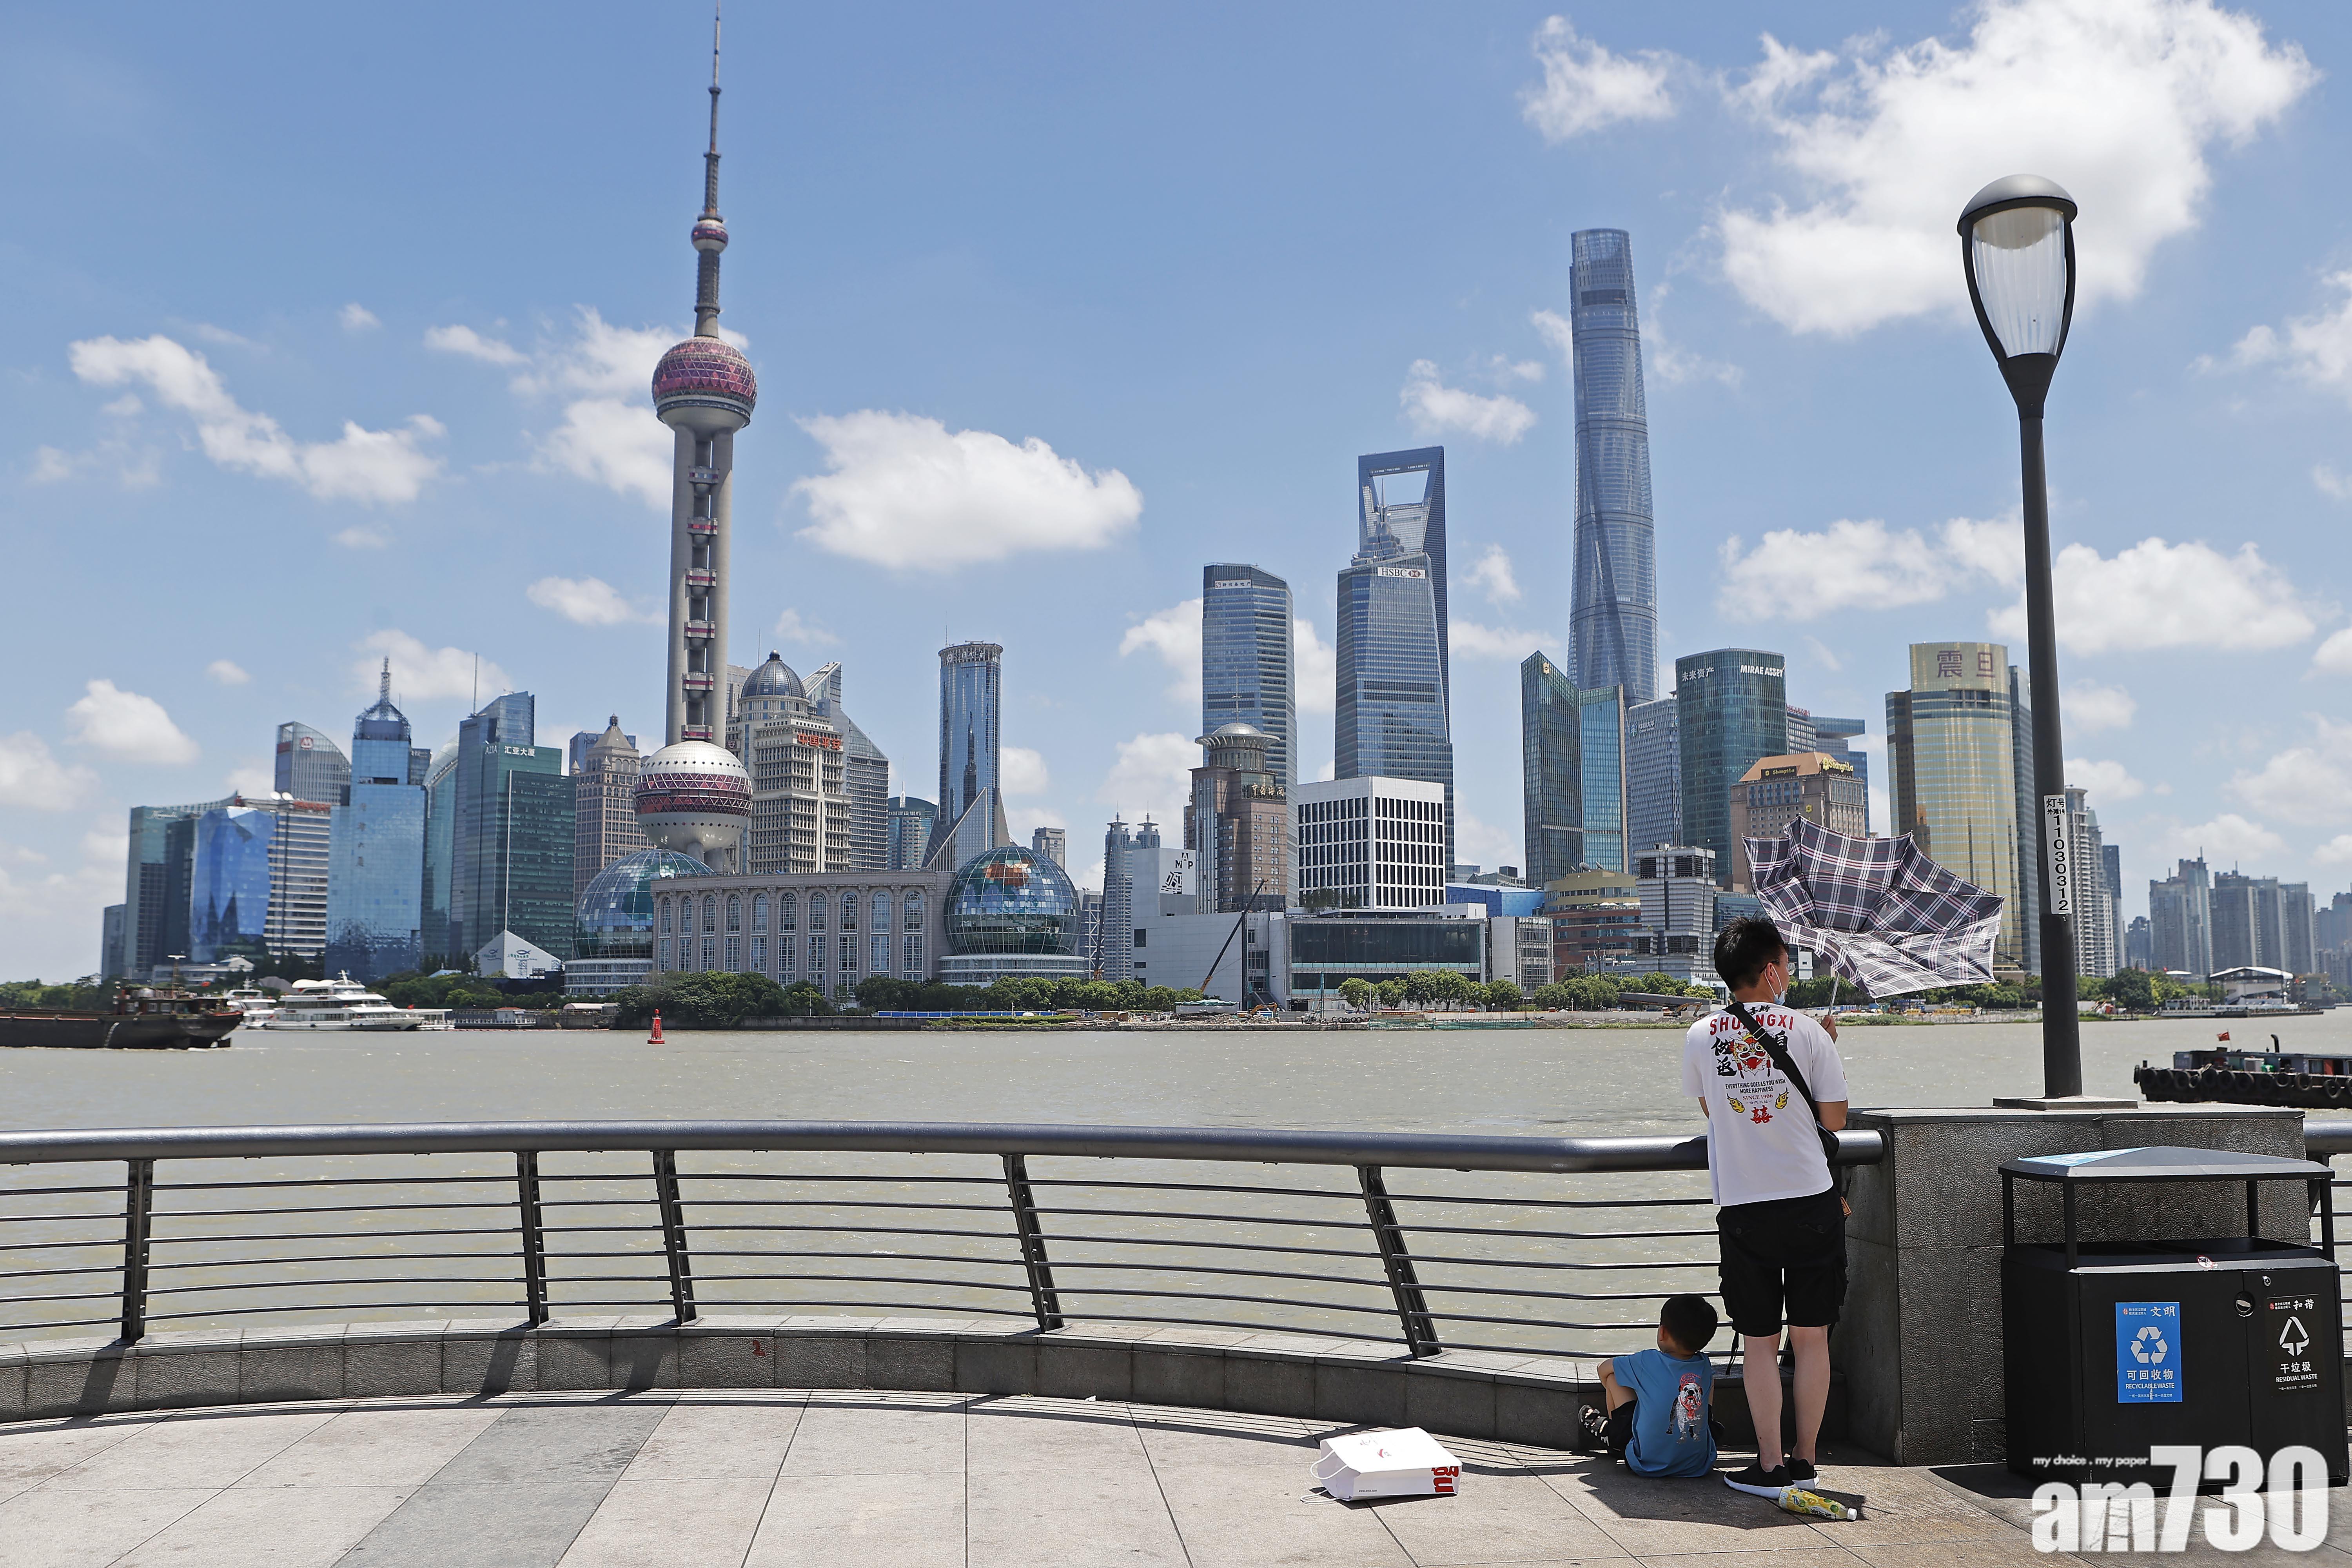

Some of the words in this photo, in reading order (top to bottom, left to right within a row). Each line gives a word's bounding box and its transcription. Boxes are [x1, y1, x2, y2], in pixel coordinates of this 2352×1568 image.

[1382, 568, 1407, 577] HSBC
[1740, 665, 1764, 675] MIRAE
[1937, 651, 1995, 678] 震旦
[1682, 666, 1715, 682] 未来资产
[798, 733, 841, 750] 中国平安
[505, 746, 535, 757] 汇亚大厦
[2046, 798, 2065, 808] 灯号
[2053, 815, 2069, 910] 11030312
[1710, 1014, 1794, 1036] SHUNGXI
[2293, 1298, 2314, 1311] 和谐
[2150, 1306, 2176, 1317] 文明
[2280, 1361, 2312, 1374] 干垃圾
[2126, 1368, 2174, 1381] 可回收物
